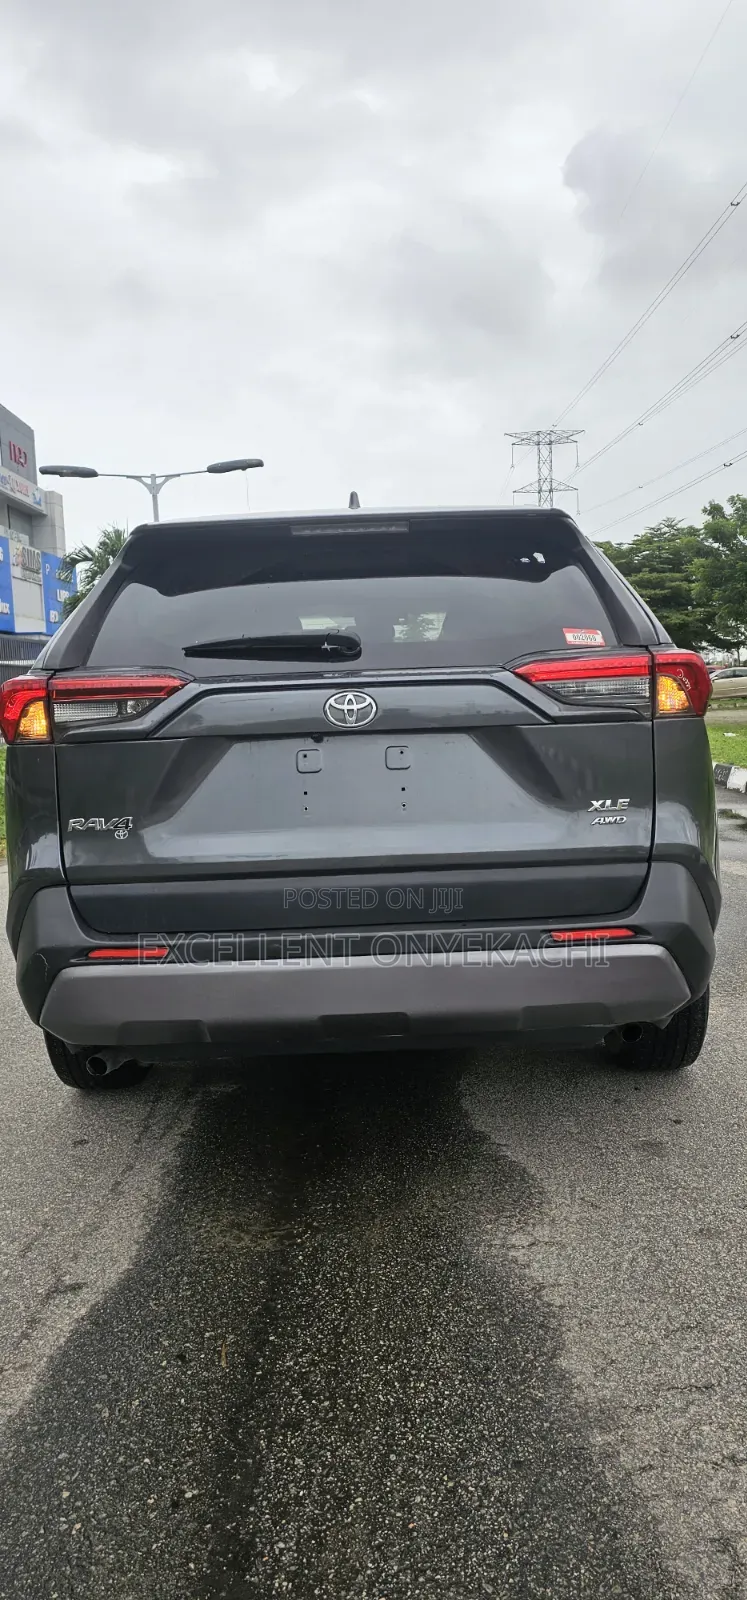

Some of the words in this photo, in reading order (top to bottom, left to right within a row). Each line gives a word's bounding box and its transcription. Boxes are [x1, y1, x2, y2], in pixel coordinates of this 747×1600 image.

[587, 798, 630, 812] XLE
[67, 816, 133, 832] RAV4
[591, 816, 627, 826] AWD
